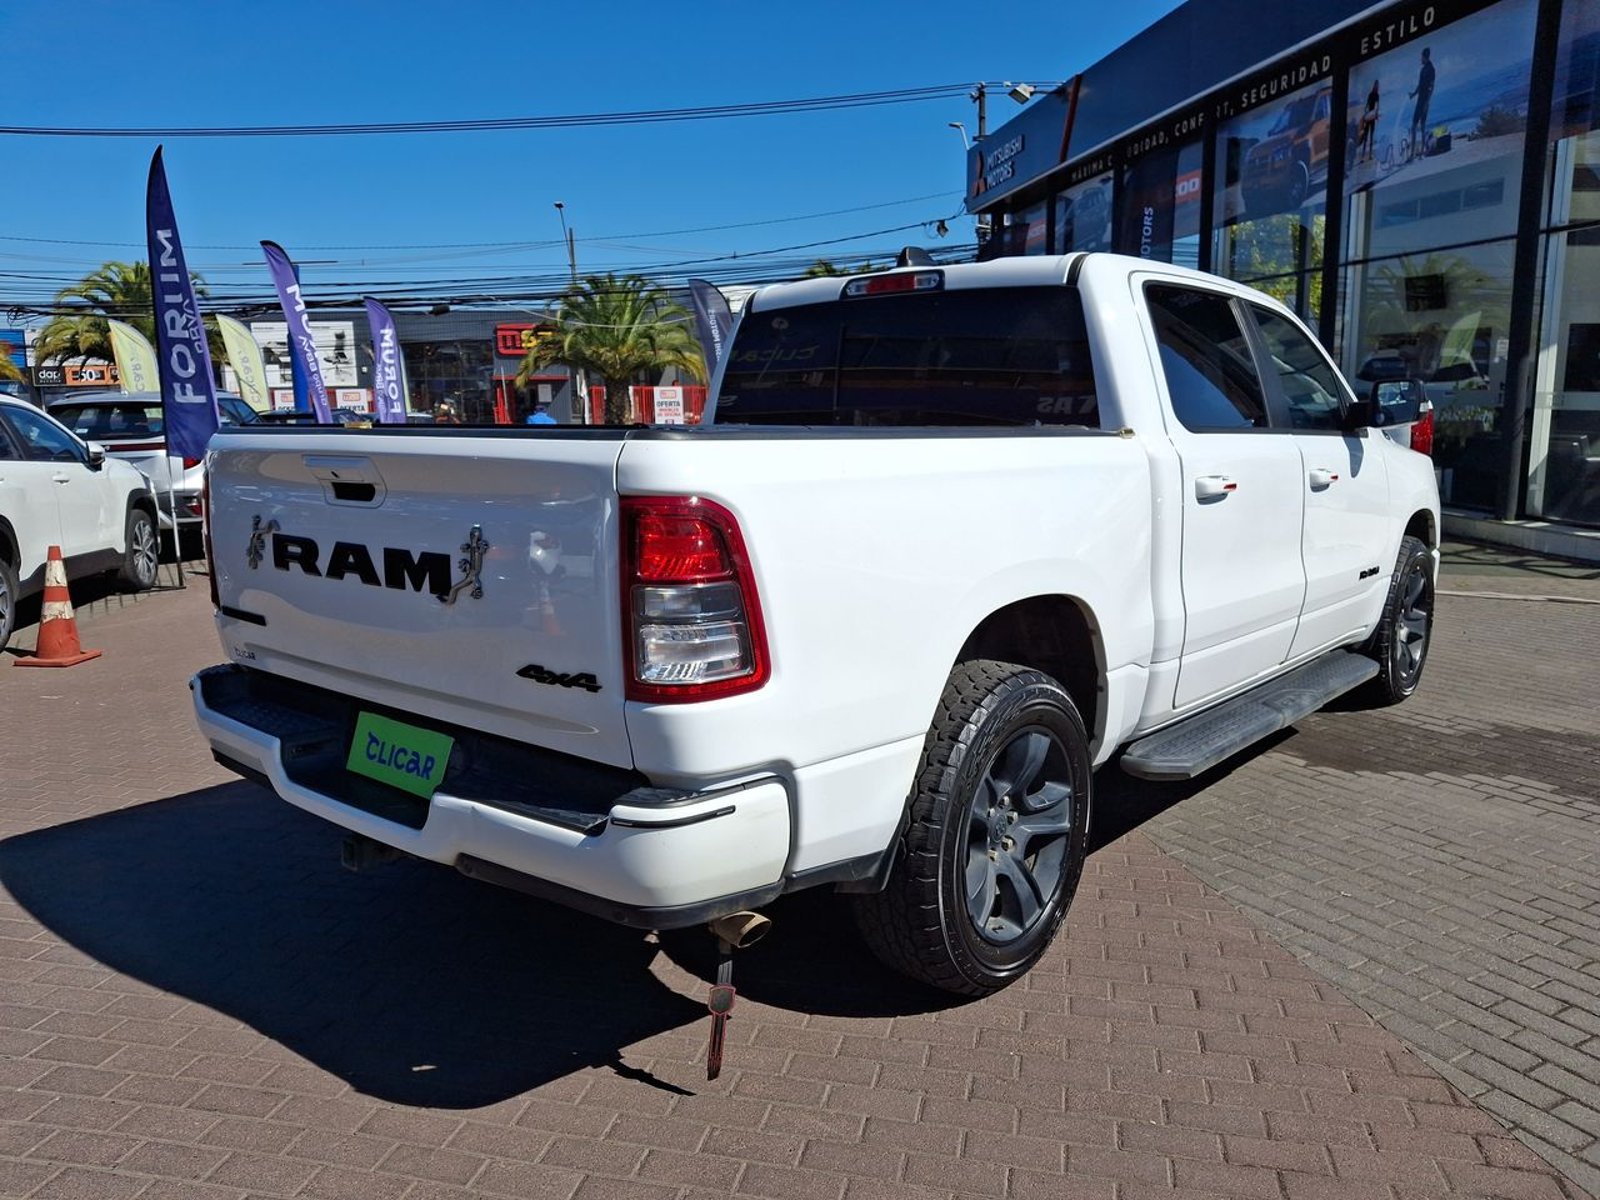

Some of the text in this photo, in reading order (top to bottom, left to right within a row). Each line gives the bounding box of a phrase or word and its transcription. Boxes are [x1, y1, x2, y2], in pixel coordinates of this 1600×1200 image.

[1241, 55, 1331, 108] SEGURIDAD
[1361, 6, 1435, 55] ESTILO
[1140, 206, 1154, 257] OTORS
[272, 533, 451, 597] RAM
[516, 664, 602, 693] 4x4
